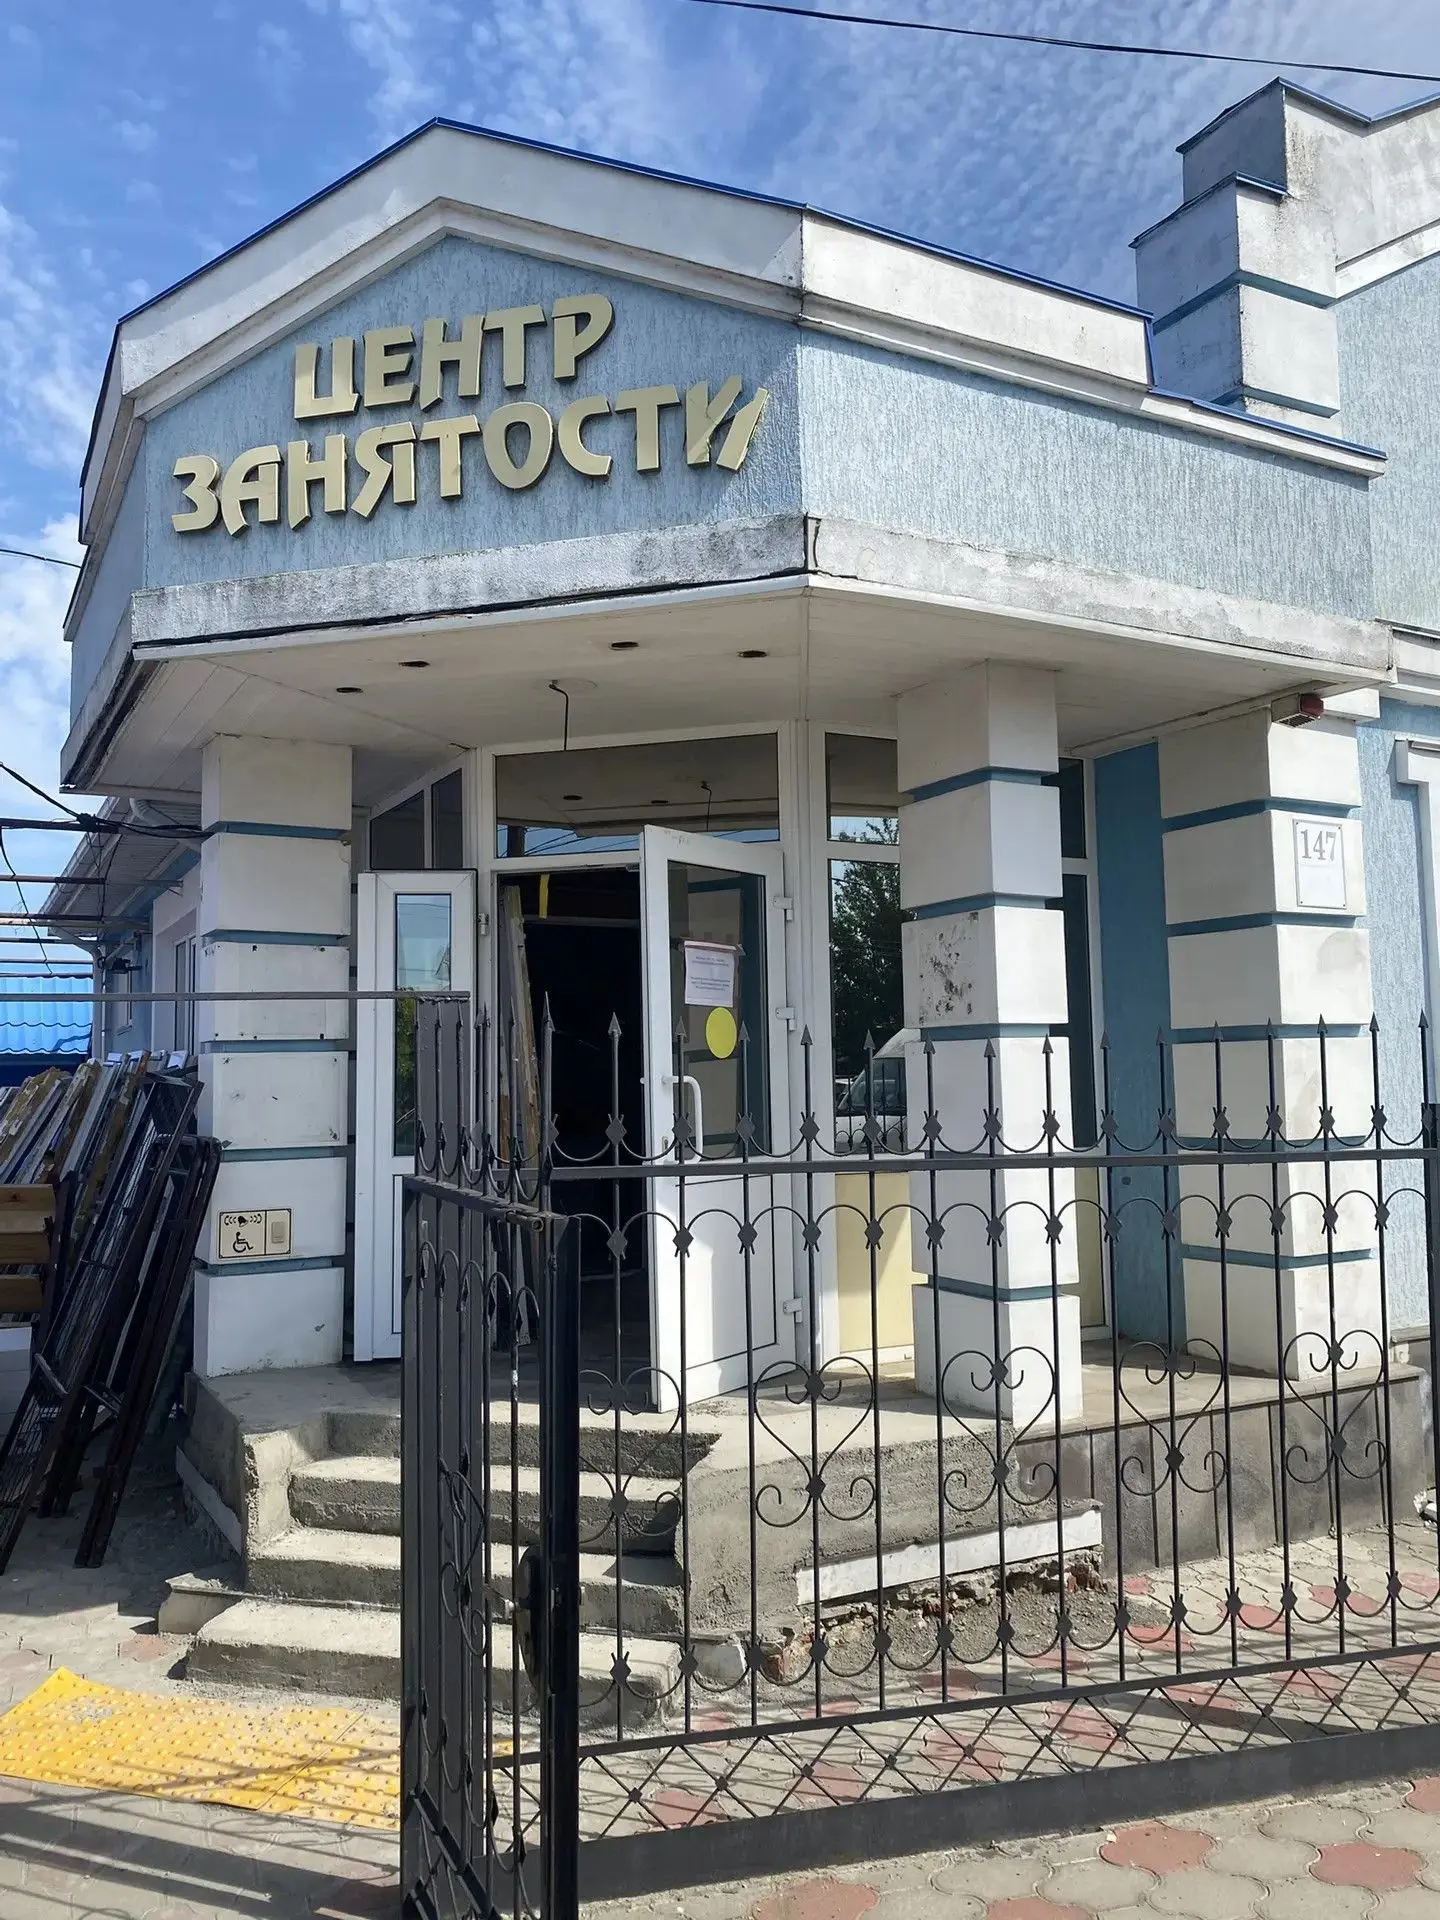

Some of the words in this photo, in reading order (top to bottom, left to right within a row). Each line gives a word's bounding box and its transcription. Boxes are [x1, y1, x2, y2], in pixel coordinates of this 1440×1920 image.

[293, 293, 614, 420] ЦЕНТР
[172, 375, 769, 536] ЗАНЯТОСТИ
[1300, 829, 1337, 861] 147
